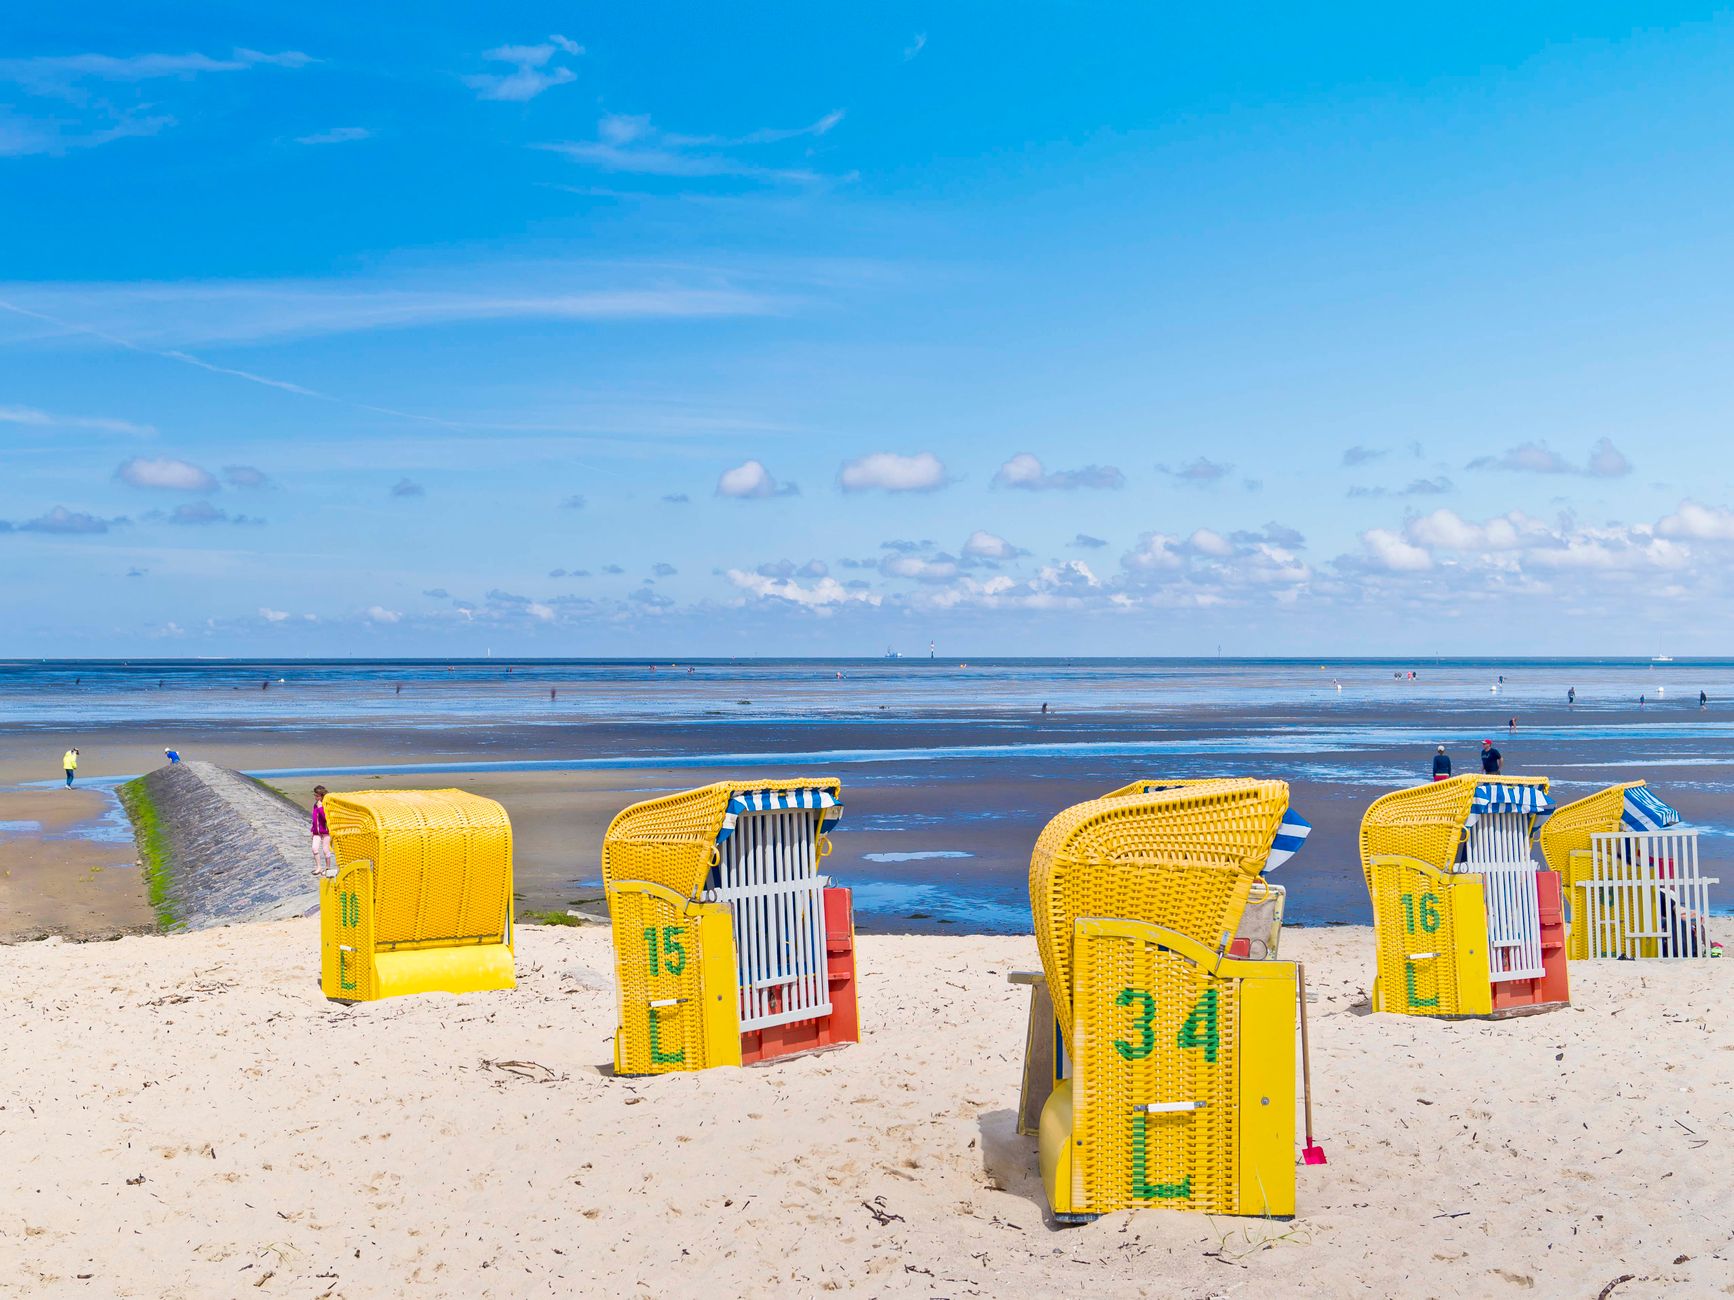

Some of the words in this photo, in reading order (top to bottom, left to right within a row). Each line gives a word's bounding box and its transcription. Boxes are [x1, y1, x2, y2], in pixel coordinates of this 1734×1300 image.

[340, 891, 359, 928] 10
[1401, 893, 1441, 935] 16
[341, 950, 357, 989] L
[644, 926, 686, 977] 15
[1406, 961, 1440, 1007] L
[650, 1009, 686, 1063] L
[1114, 987, 1219, 1063] 34
[1132, 1115, 1191, 1199] L
